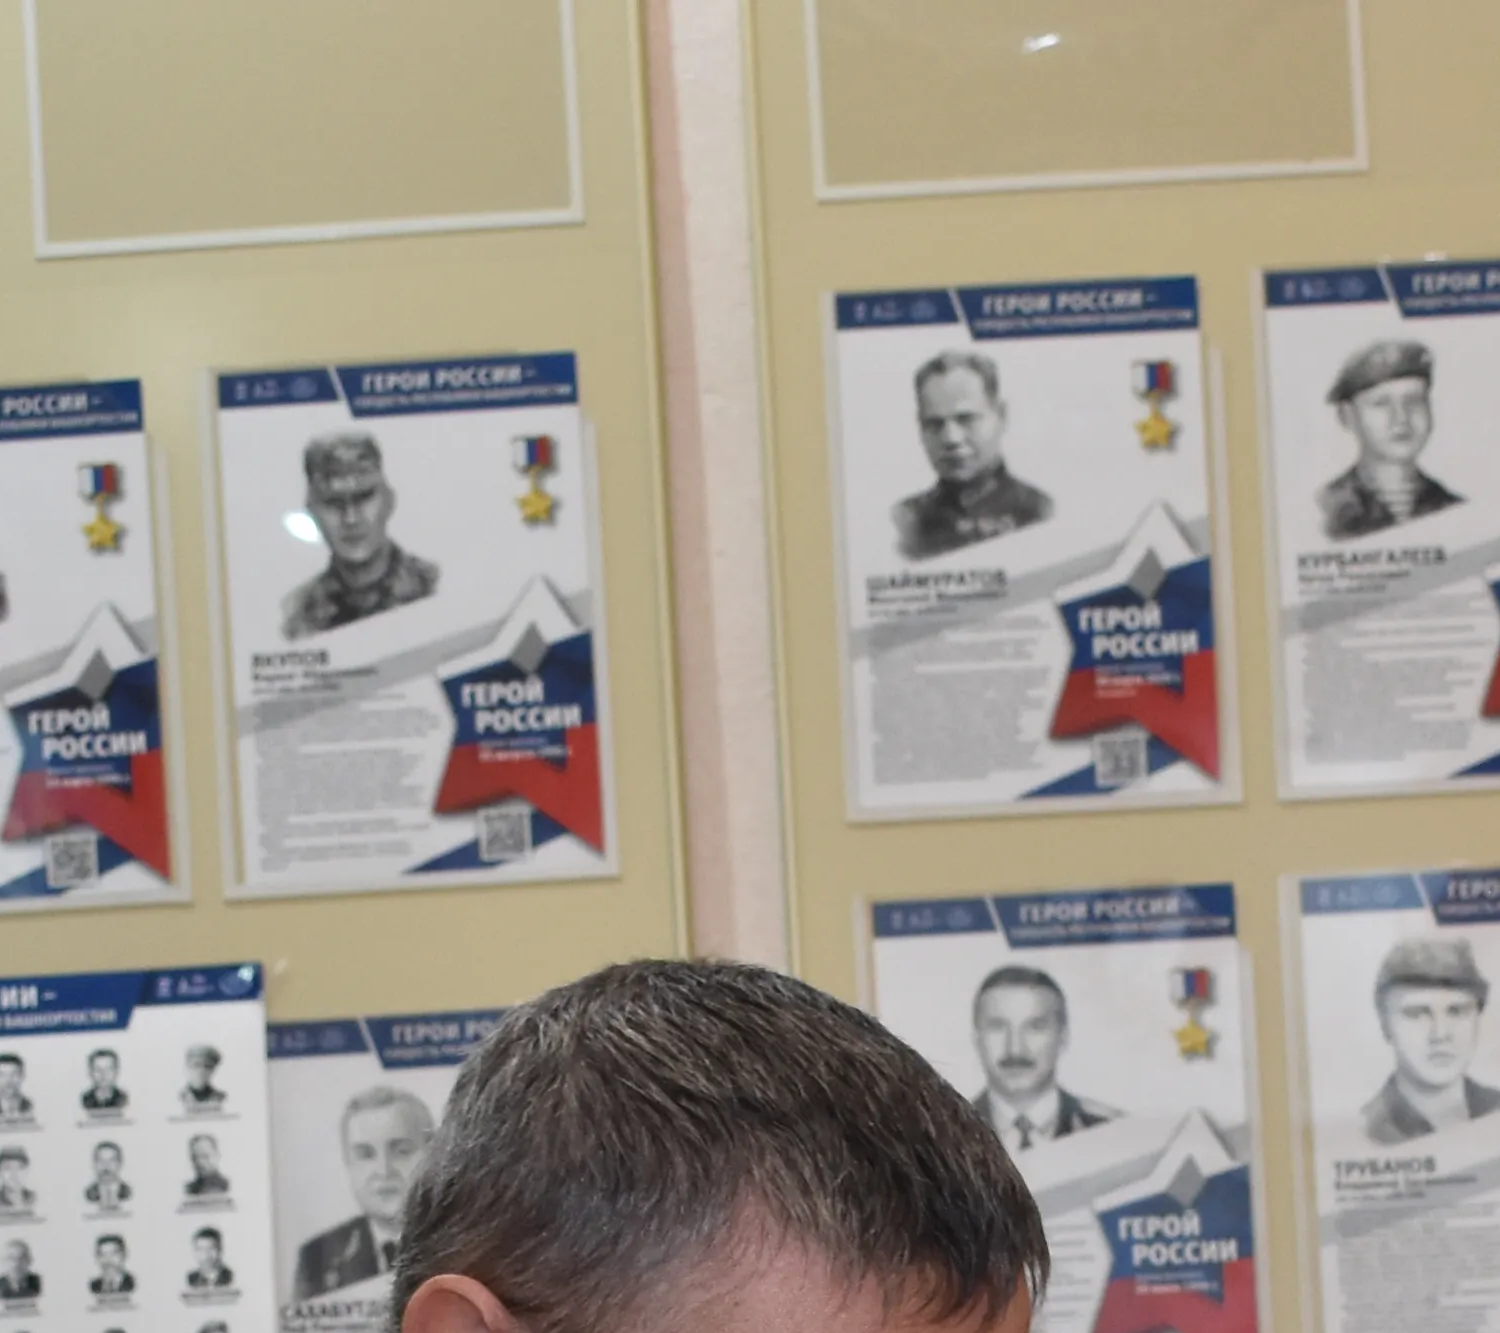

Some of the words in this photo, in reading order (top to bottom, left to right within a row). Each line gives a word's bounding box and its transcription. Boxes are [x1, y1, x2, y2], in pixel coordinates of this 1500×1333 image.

[435, 364, 522, 388] РОССИИ
[2, 392, 88, 417] РОССИИ
[1078, 603, 1162, 632] ГЕРОЙ
[1092, 630, 1198, 659] РОССИИ
[461, 677, 544, 708] ГЕРОЙ
[28, 704, 111, 735] ГЕРОЙ
[476, 703, 582, 734] РОССИИ
[41, 731, 148, 760] РОССИИ
[1118, 1208, 1201, 1240] ГЕРОЙ
[1132, 1238, 1238, 1267] РОССИИ
